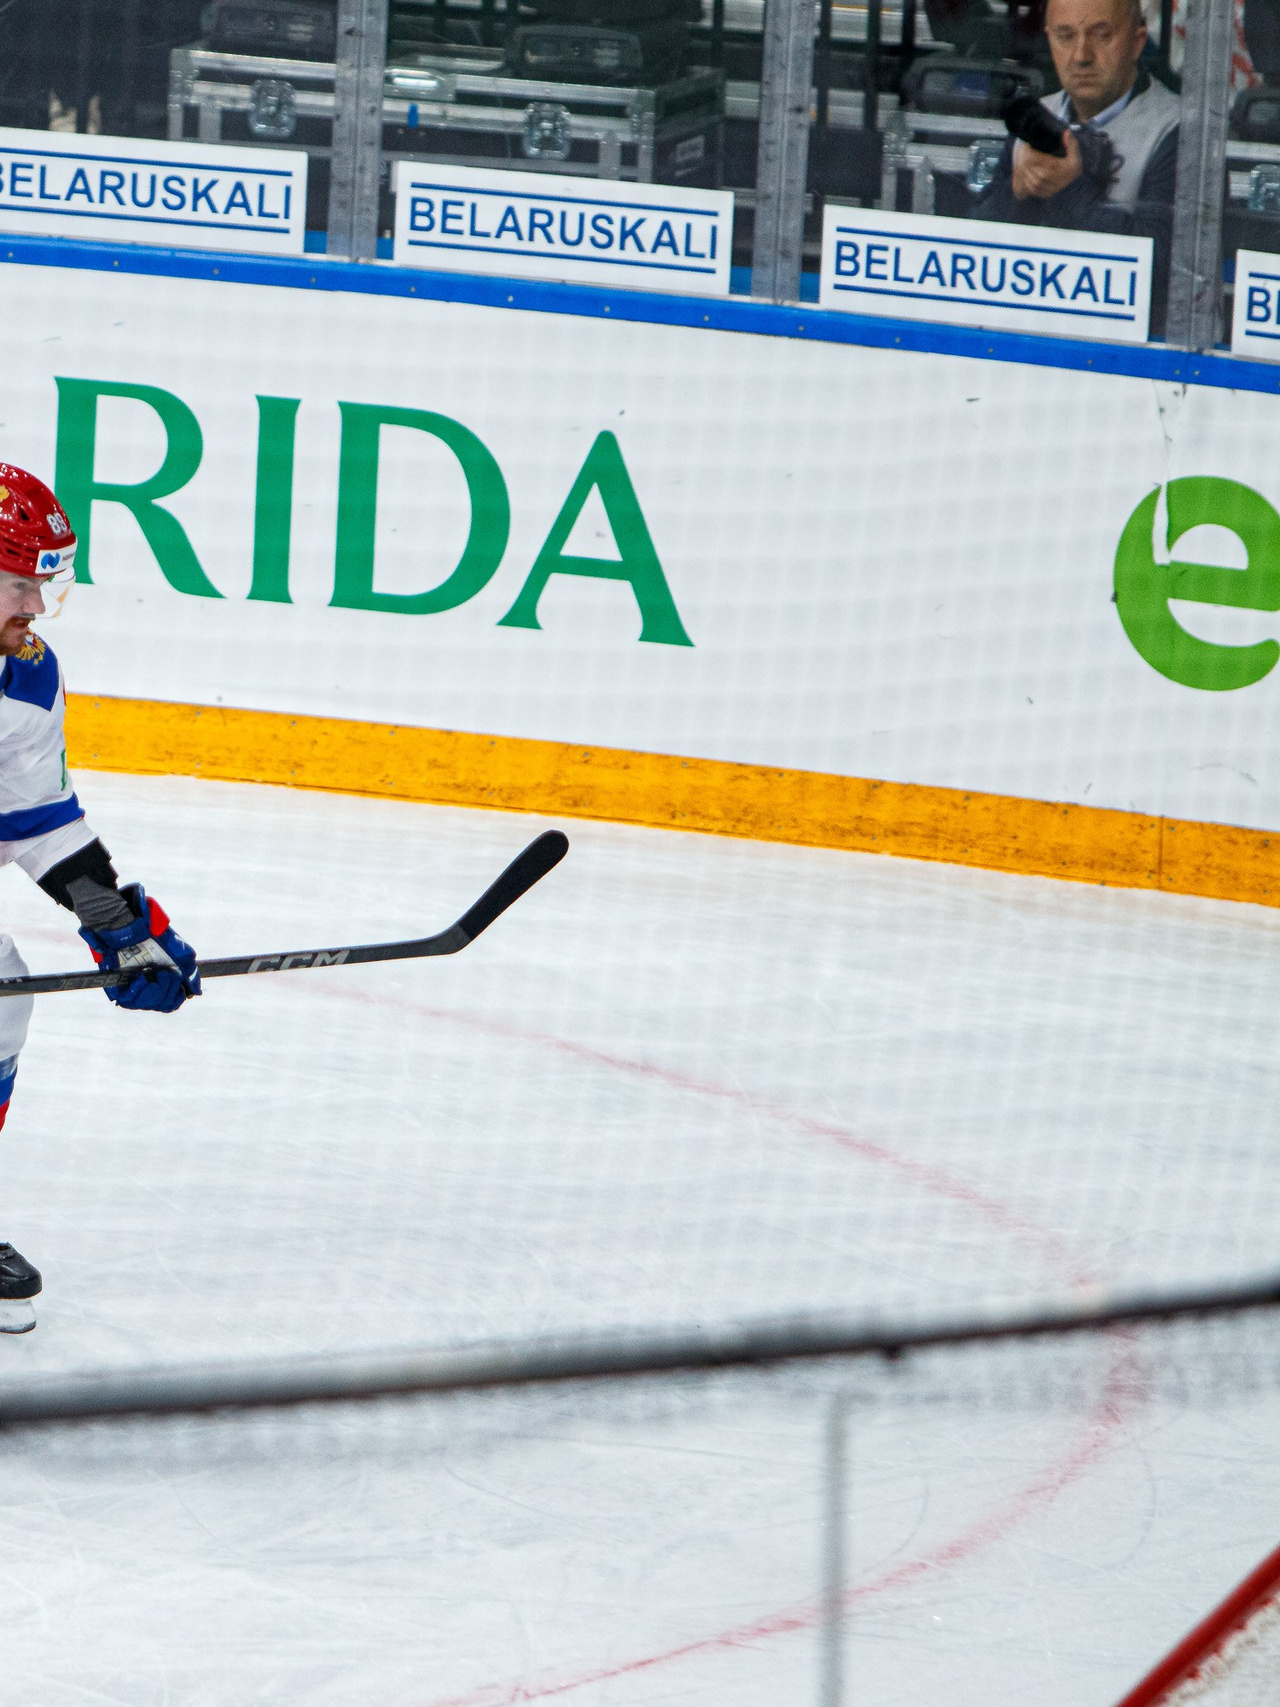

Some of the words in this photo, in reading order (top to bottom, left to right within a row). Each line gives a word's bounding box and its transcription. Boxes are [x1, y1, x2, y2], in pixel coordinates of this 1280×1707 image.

[408, 197, 718, 260] BELARUSKALI
[833, 241, 1137, 307] BELARUSKALI
[1246, 286, 1280, 325] B
[247, 949, 350, 974] CCM
